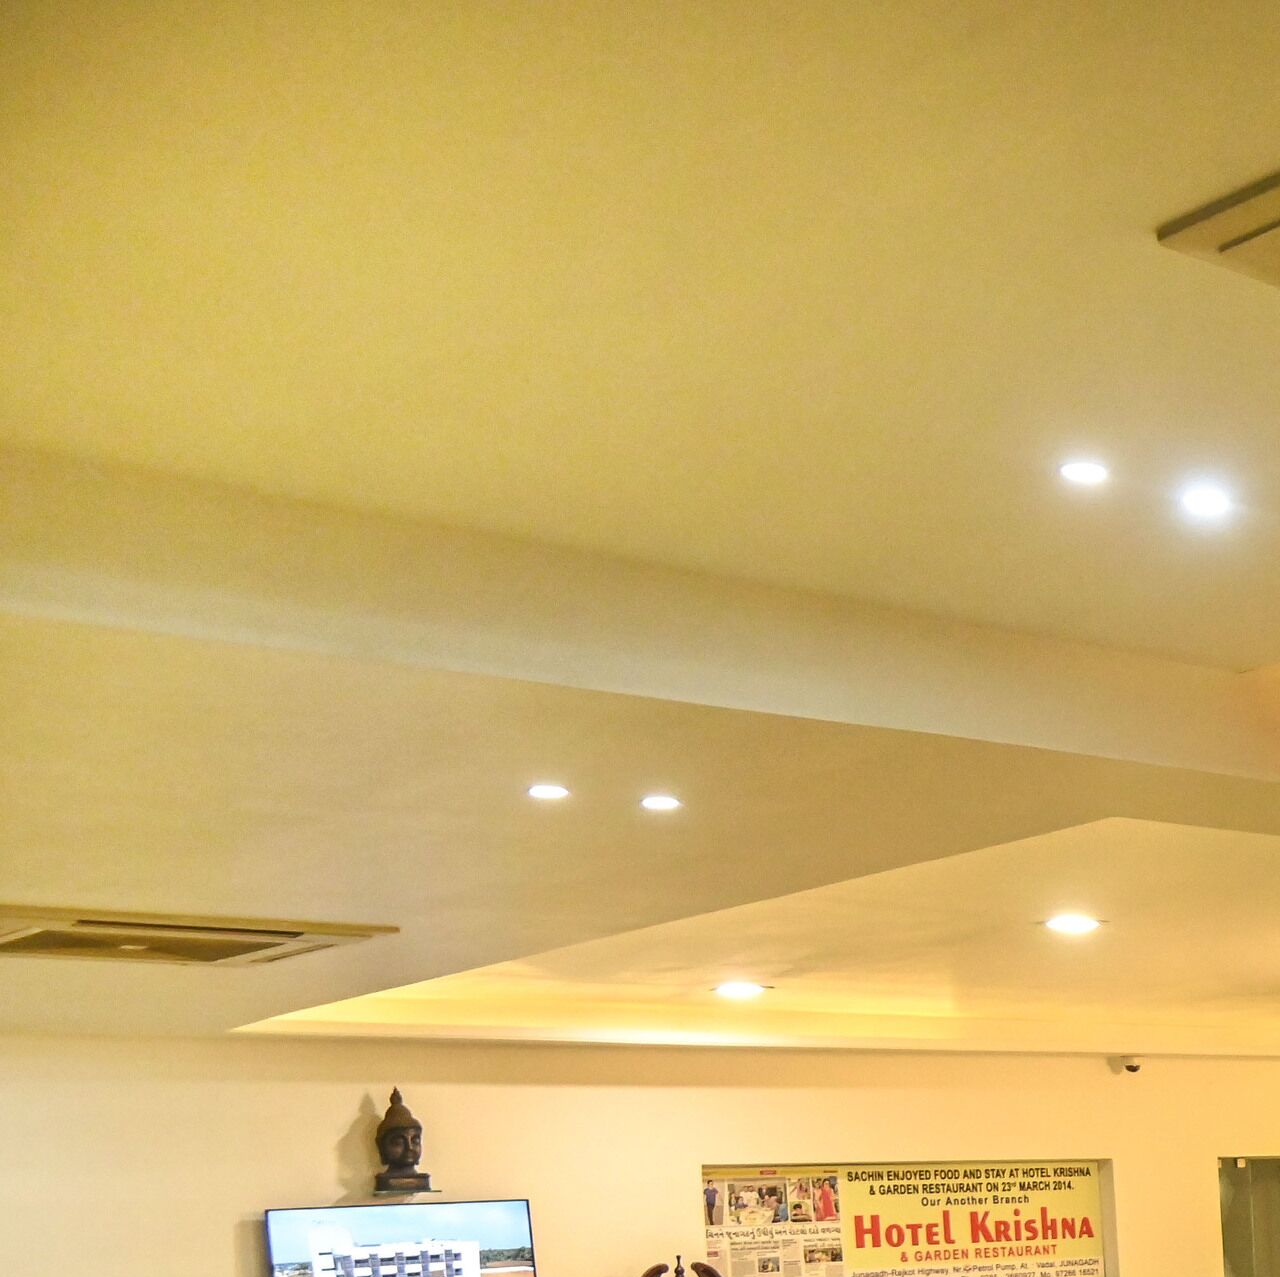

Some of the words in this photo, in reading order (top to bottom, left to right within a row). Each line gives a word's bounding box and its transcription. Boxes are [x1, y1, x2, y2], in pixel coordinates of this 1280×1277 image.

[847, 1171, 884, 1182] SACHIN
[887, 1170, 931, 1181] ENJOYED
[934, 1169, 960, 1180] FOOD
[963, 1169, 982, 1179] AND
[985, 1168, 1006, 1179] STAY
[1009, 1168, 1020, 1178] AT
[1022, 1167, 1051, 1178] HOTEL
[1053, 1167, 1091, 1177] KRISHNA
[869, 1185, 876, 1195] &
[878, 1184, 919, 1195] GARDEN
[922, 1182, 983, 1194] RESTAURANT
[986, 1182, 999, 1192] ON
[1019, 1180, 1051, 1191] MARCH
[1053, 1180, 1075, 1191] 2014.
[921, 1197, 941, 1206] Our
[945, 1195, 988, 1206] Another
[993, 1194, 1030, 1205] Branch
[900, 1251, 908, 1263] &
[914, 1249, 969, 1262] GARDEN
[974, 1244, 1058, 1260] RESTAURANT
[972, 1264, 993, 1272] Petrol
[1059, 1258, 1099, 1267] JUNAGADH
